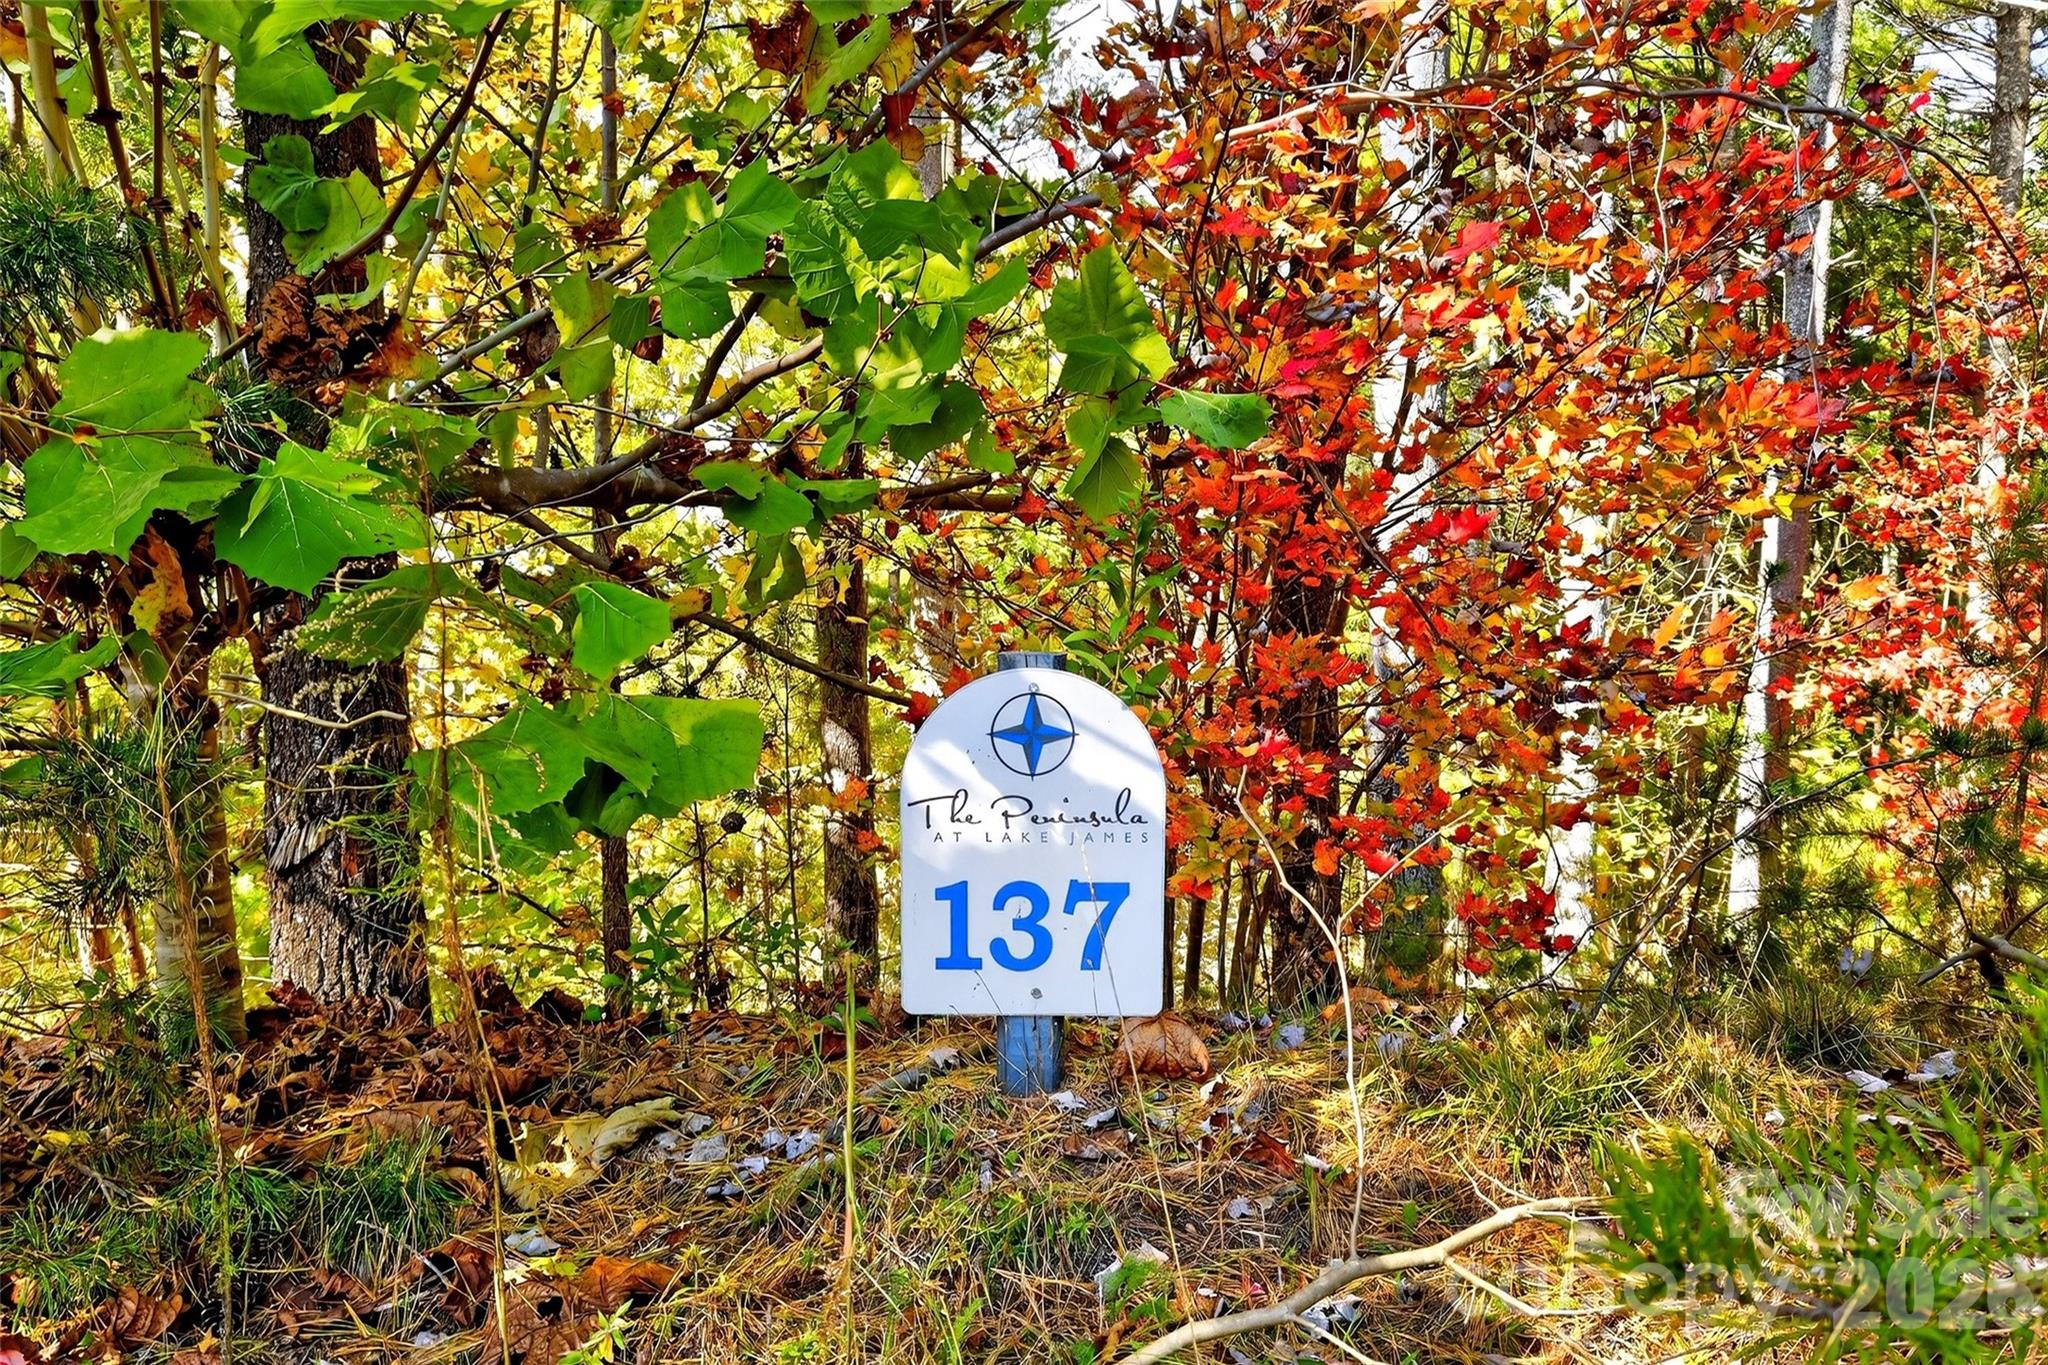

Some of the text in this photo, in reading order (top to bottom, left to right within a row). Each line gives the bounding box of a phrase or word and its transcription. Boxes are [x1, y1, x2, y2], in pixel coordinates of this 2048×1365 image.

[907, 787, 1149, 829] The Peninsula
[933, 831, 1150, 846] AT LAKE JAMES
[934, 879, 1130, 972] 137
